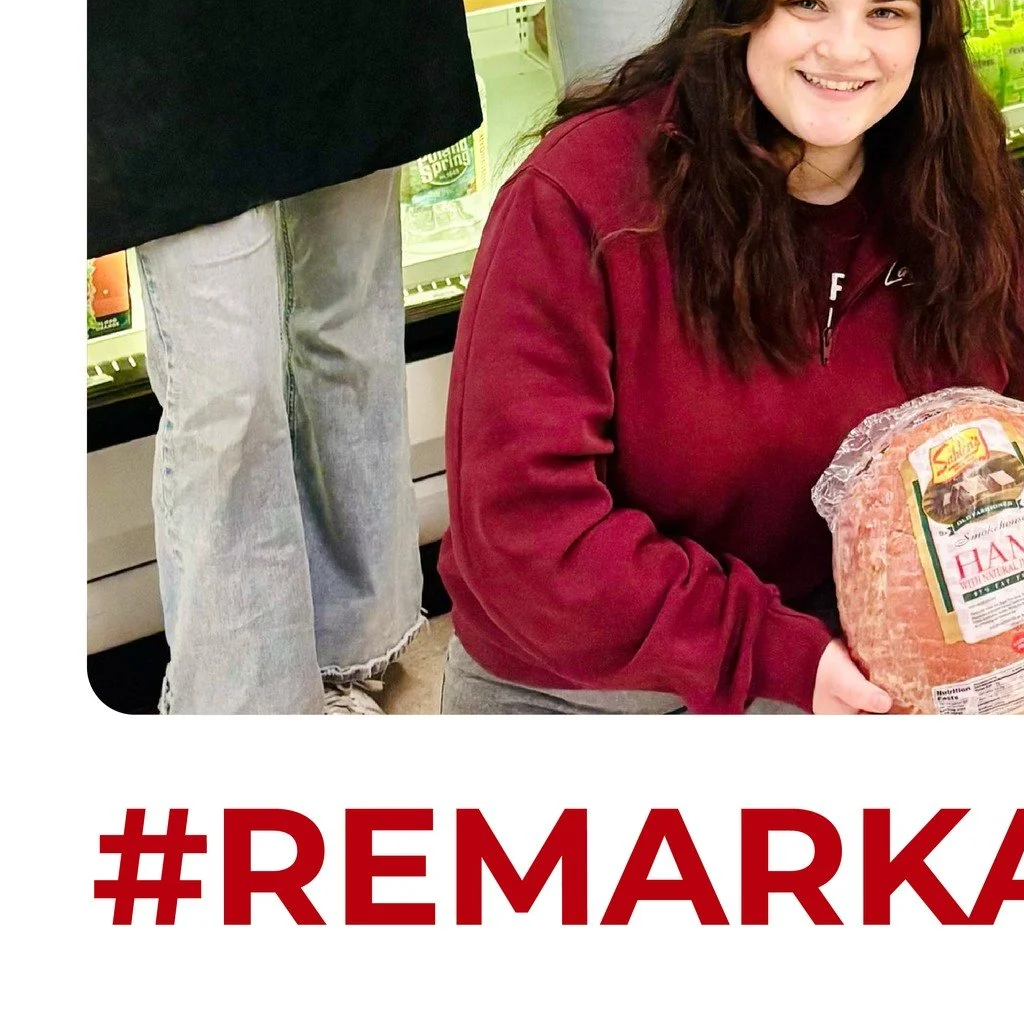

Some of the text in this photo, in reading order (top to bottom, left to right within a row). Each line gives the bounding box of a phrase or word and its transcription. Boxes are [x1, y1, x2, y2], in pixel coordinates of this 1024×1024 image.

[419, 151, 470, 184] Spring
[959, 574, 982, 590] WITH
[982, 564, 1018, 583] NATURAL
[936, 686, 971, 697] Nutrition
